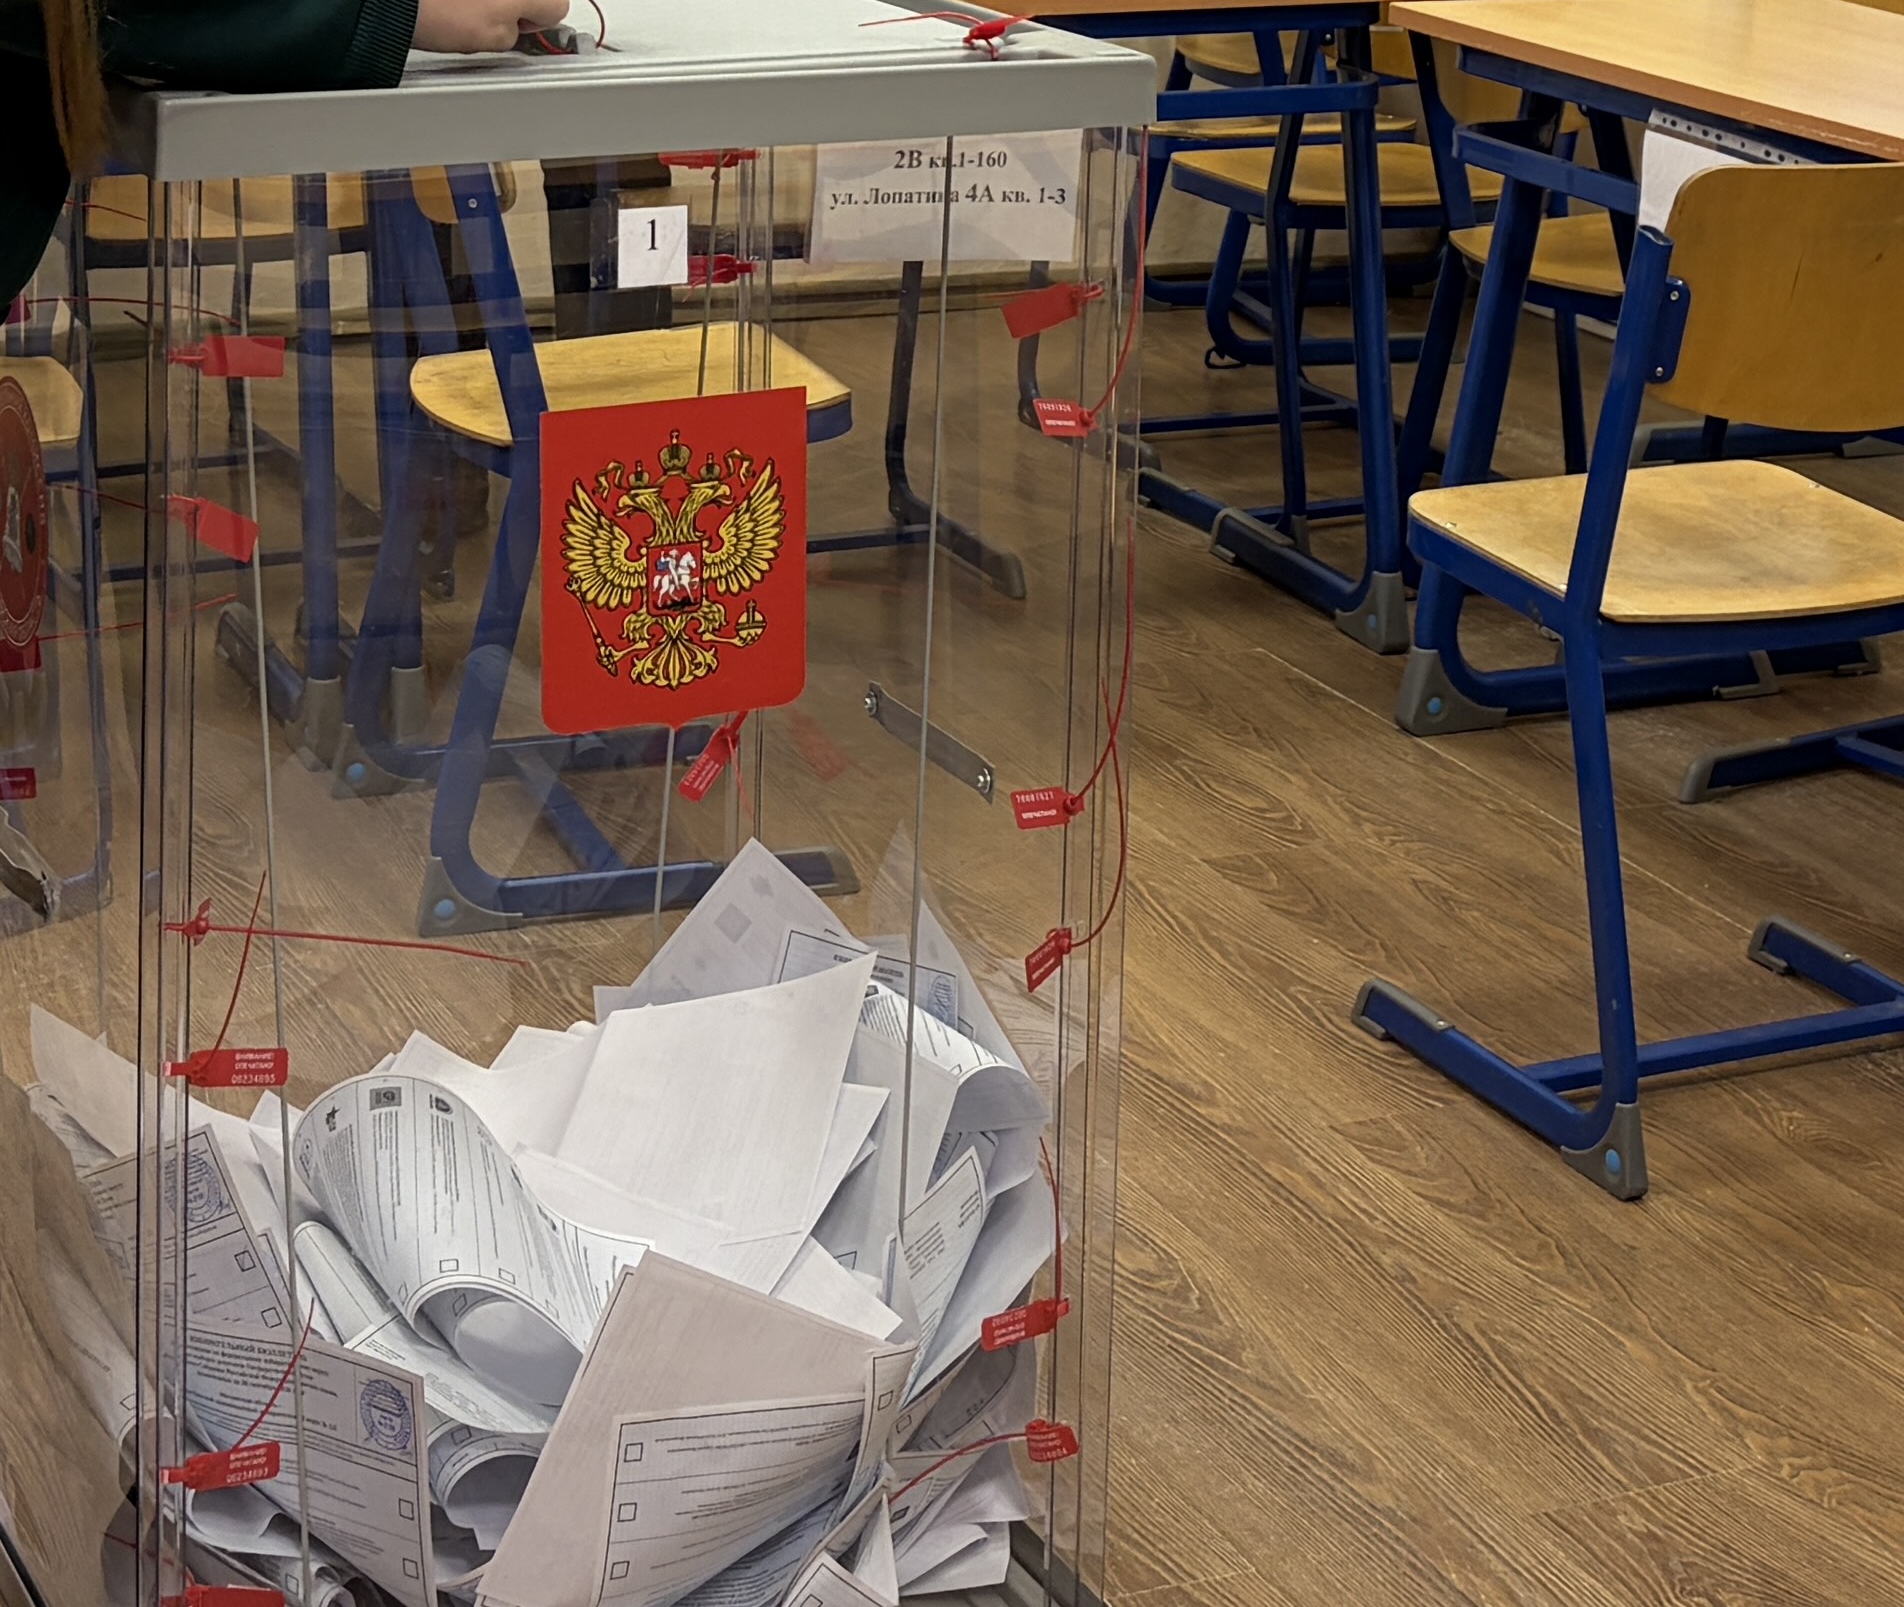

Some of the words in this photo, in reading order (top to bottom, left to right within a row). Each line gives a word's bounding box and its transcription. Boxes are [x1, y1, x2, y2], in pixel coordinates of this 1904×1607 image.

[893, 149, 922, 170] 2В
[829, 192, 859, 210] ул.
[965, 182, 995, 204] 4А
[1001, 190, 1030, 204] кв.
[1039, 186, 1067, 205] 1-3
[646, 218, 659, 252] 1
